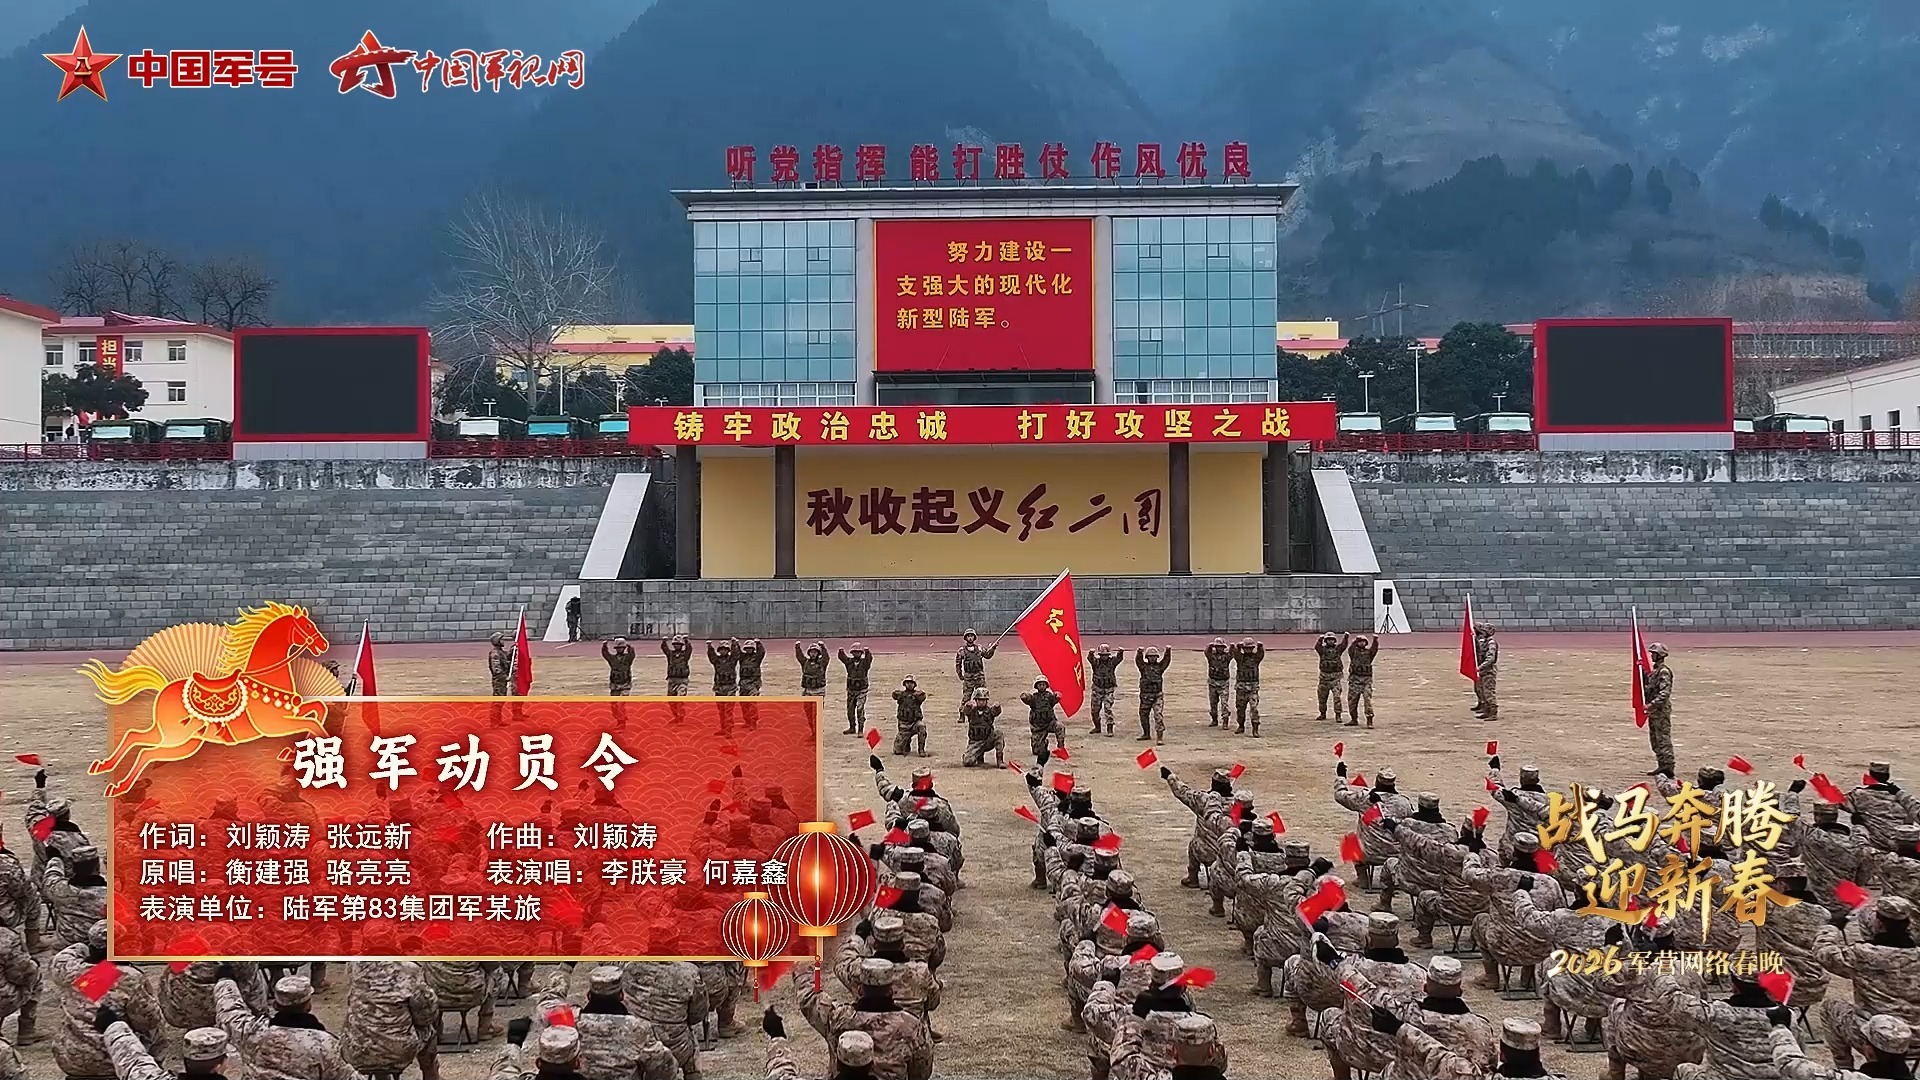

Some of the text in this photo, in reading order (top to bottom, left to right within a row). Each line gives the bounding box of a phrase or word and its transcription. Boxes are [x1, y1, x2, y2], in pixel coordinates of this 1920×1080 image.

[725, 141, 1251, 182] 听党指挥 能打胜仗 作风优良
[947, 240, 1072, 263] 努力建设一
[896, 273, 1073, 296] 支强大的现代化
[896, 307, 1010, 330] 新型陆军。
[673, 408, 1291, 442] 铸牢政治忠诚 打好攻坚之战
